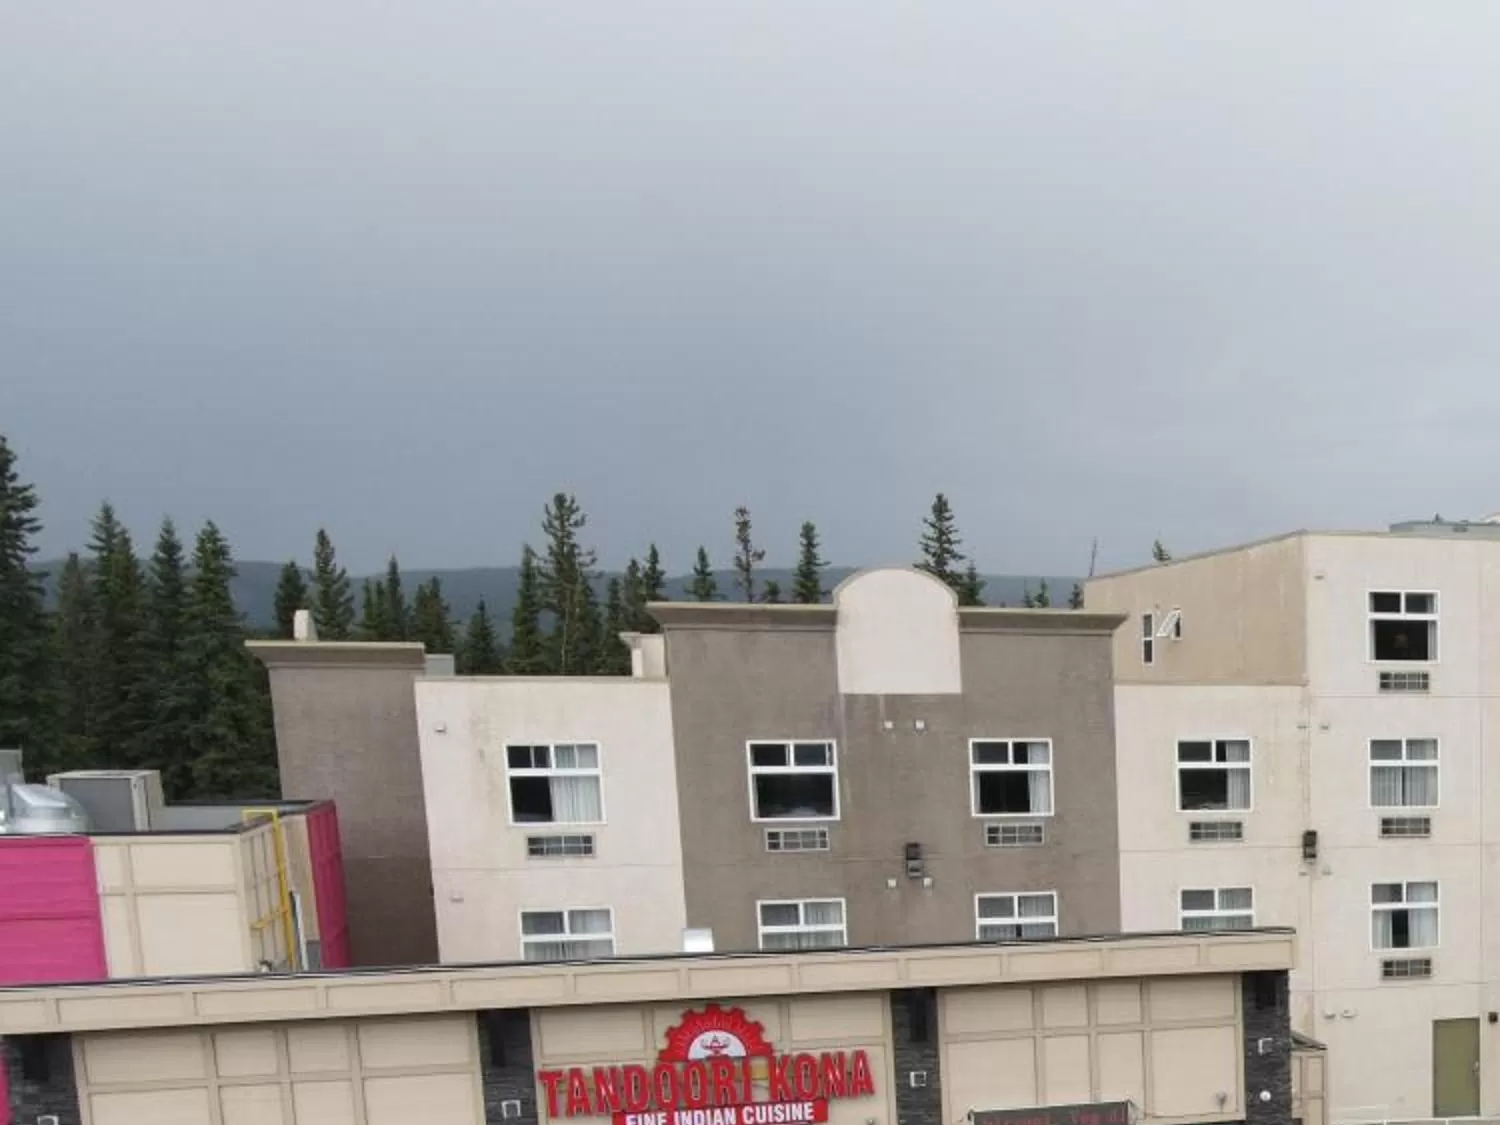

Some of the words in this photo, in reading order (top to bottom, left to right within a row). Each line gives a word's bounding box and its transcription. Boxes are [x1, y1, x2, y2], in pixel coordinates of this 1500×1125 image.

[538, 1054, 750, 1118] TANDOORI
[768, 1050, 876, 1102] KONA
[744, 1101, 814, 1125] CUISINE
